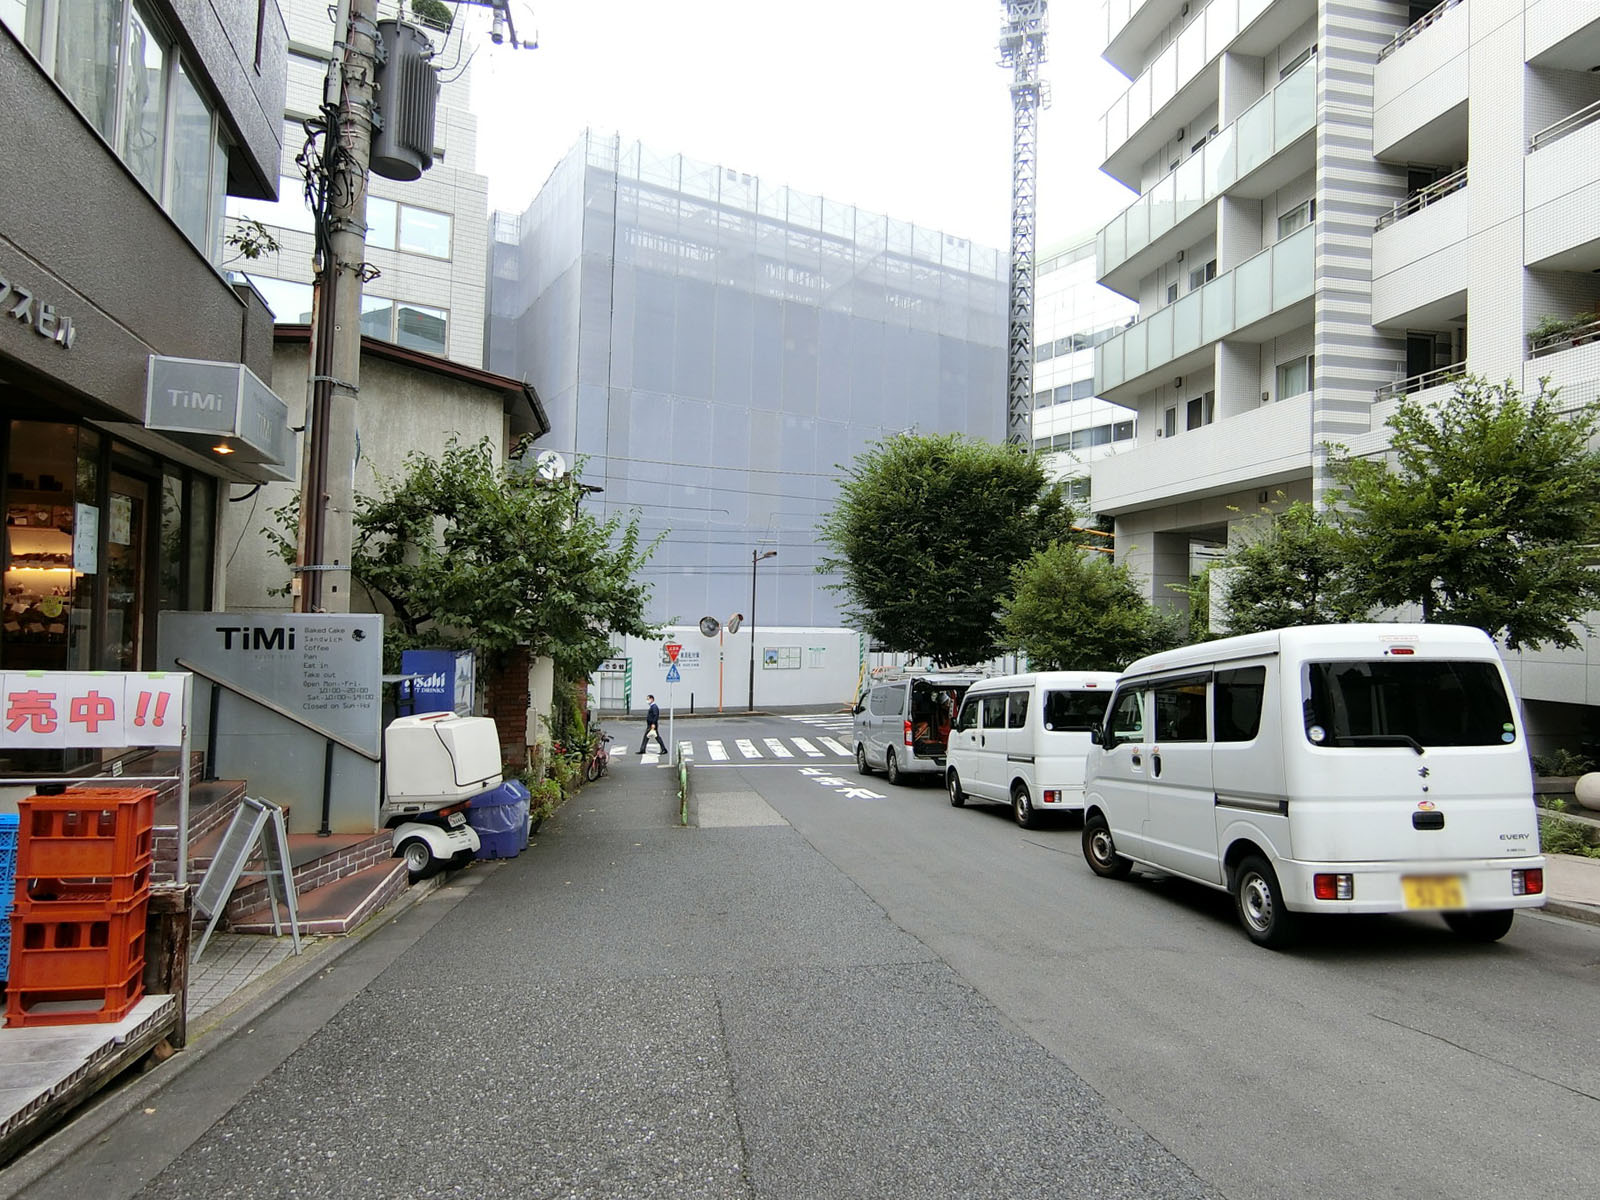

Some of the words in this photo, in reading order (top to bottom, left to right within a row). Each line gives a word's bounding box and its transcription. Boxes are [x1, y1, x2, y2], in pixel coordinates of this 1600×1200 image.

[167, 389, 223, 411] TiMi
[215, 627, 296, 650] TiMi
[1499, 833, 1530, 841] EVERY
